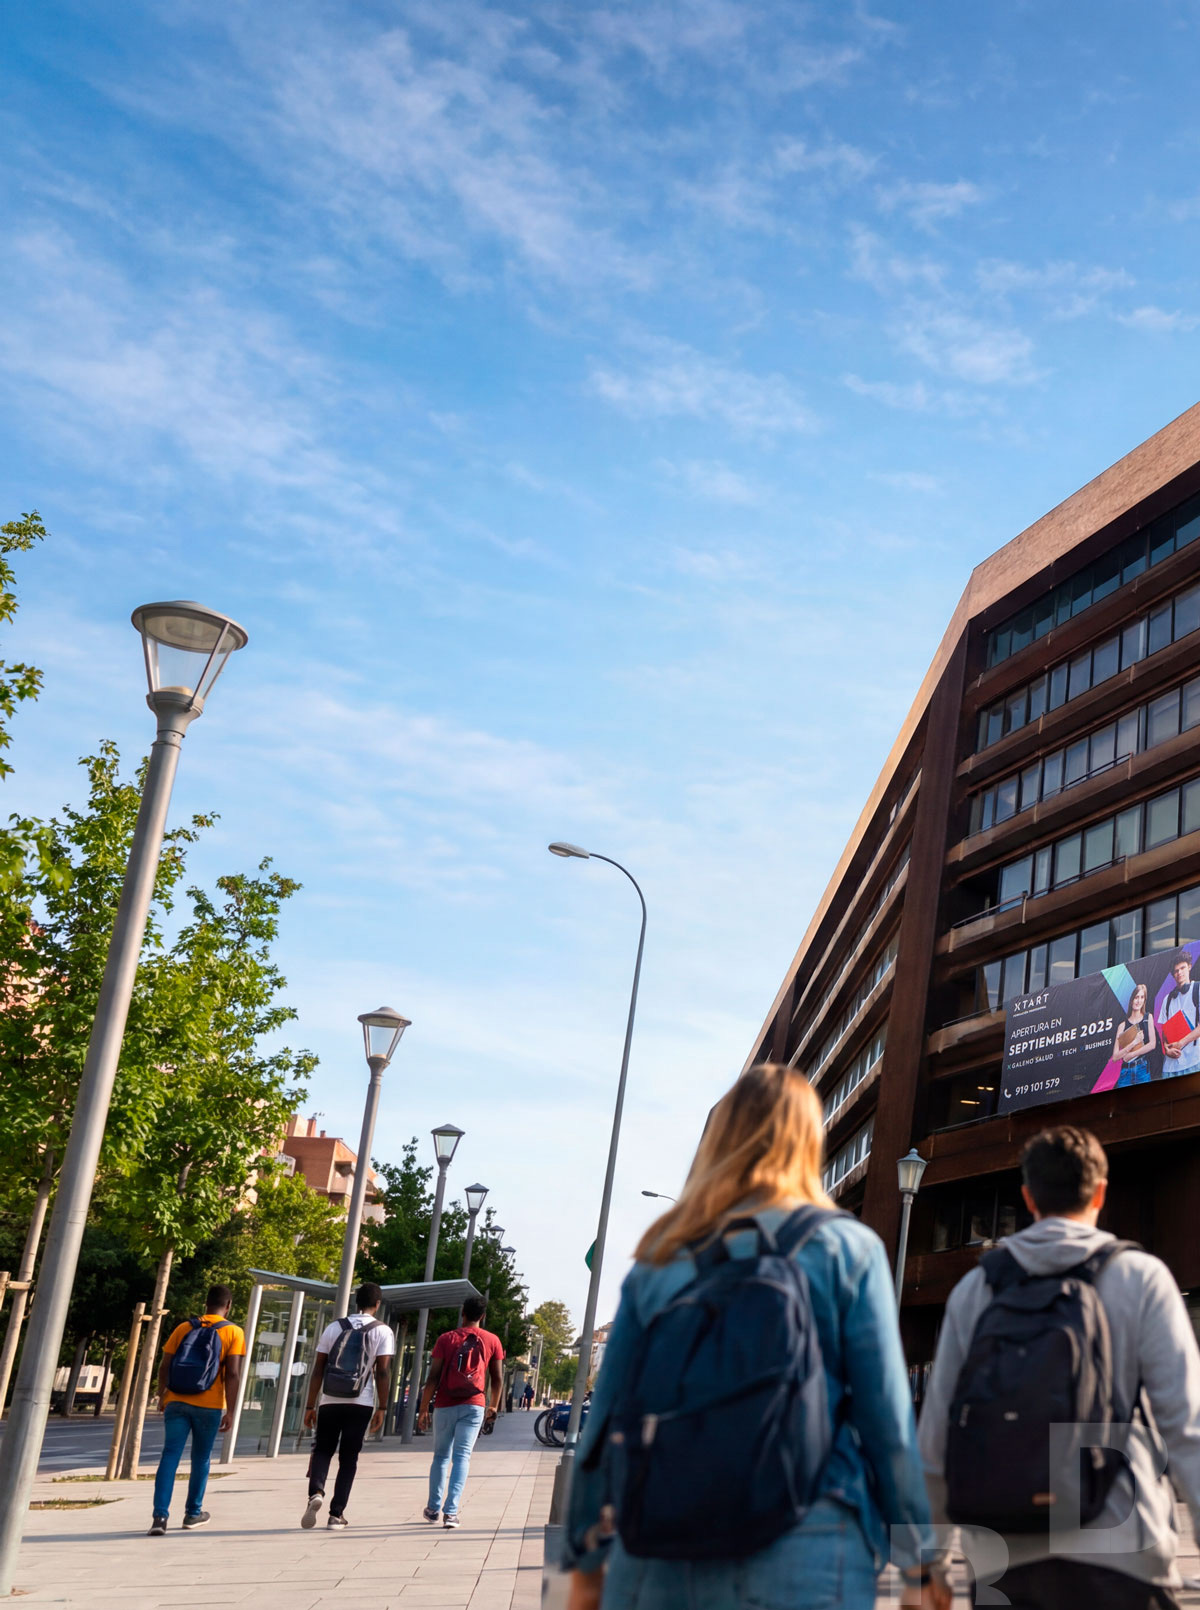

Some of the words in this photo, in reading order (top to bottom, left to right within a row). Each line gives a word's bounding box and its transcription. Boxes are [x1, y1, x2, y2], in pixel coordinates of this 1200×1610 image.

[1014, 993, 1049, 1012] XTART
[1008, 1028, 1078, 1057] SEPTIEMBRE
[1080, 1018, 1113, 1038] 2025
[1010, 1022, 1050, 1040] APERTURA
[1050, 1017, 1062, 1029] EN
[1035, 1053, 1054, 1064] SALUD
[1062, 1047, 1078, 1057] TECH
[1084, 1038, 1112, 1051] BUSINESS
[1015, 1084, 1029, 1096] 919
[1030, 1080, 1044, 1093] 101
[1045, 1077, 1060, 1089] 579
